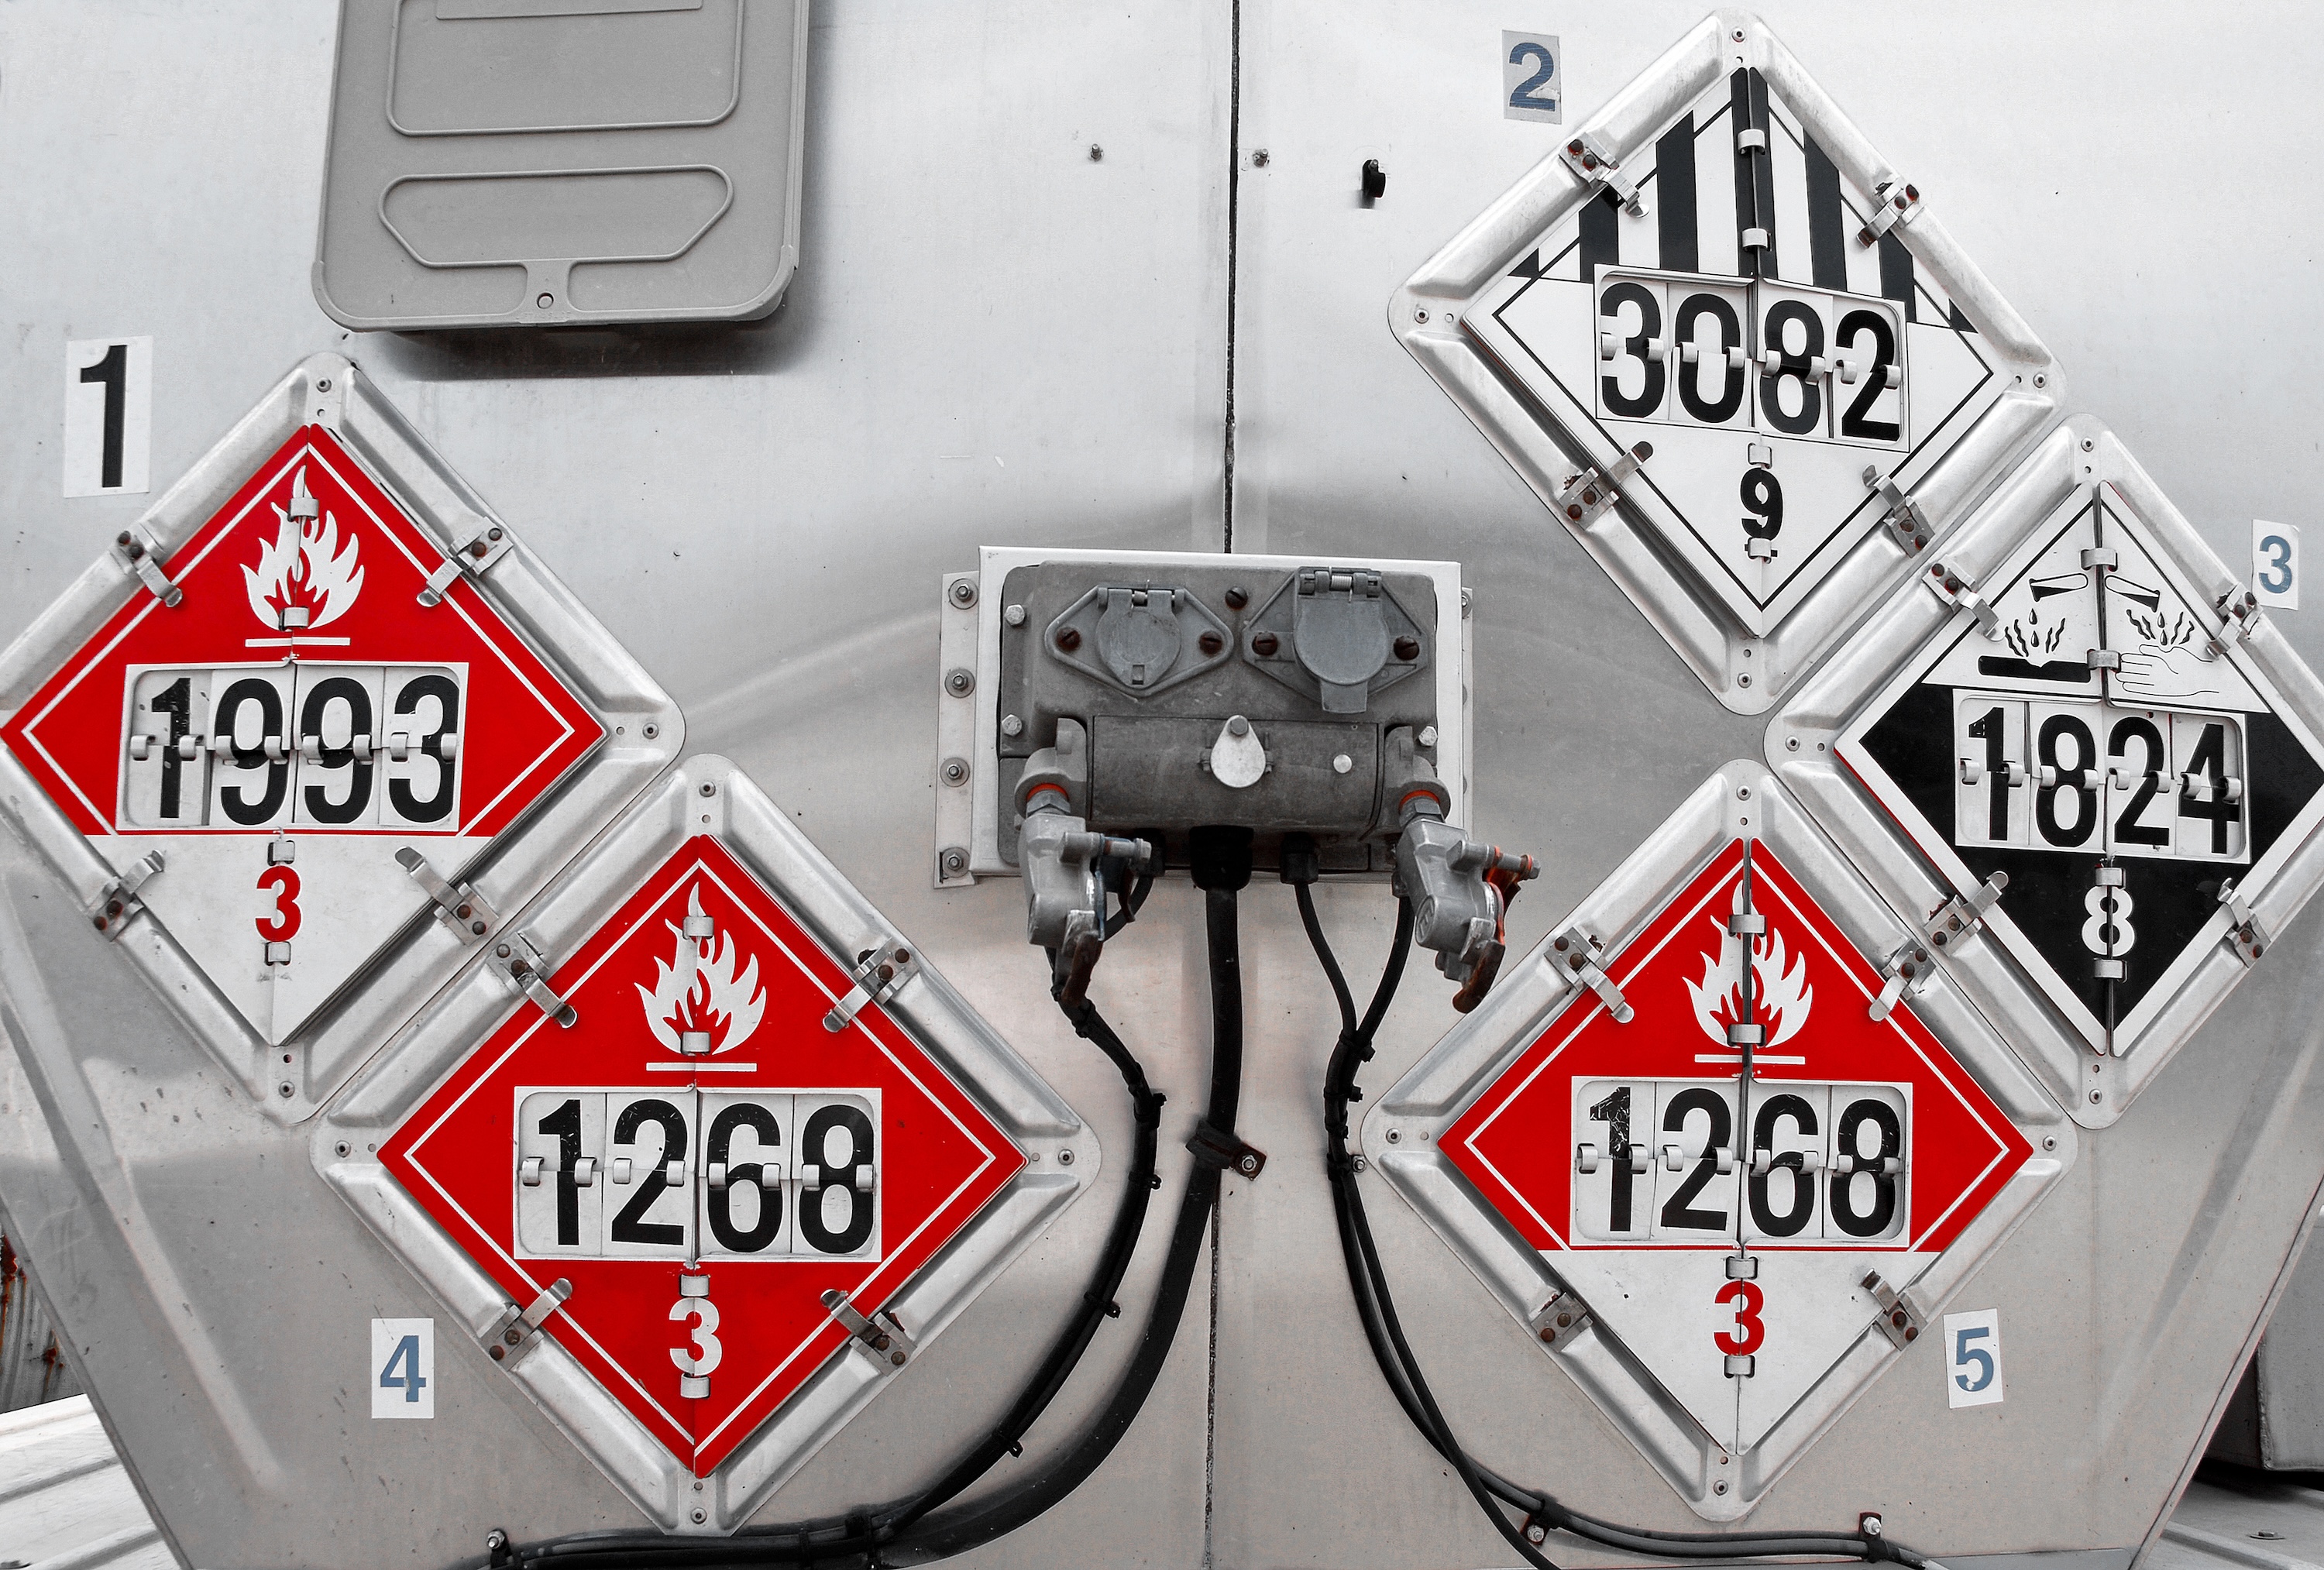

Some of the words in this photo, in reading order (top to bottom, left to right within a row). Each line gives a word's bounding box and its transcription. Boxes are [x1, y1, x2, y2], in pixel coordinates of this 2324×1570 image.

[1508, 43, 1556, 113] 2
[1600, 281, 1900, 442] 3082
[79, 345, 128, 489] 1
[1739, 467, 1783, 542] 9
[2258, 534, 2291, 594] 3
[151, 675, 460, 826] 1993
[1968, 706, 2240, 854] 1824
[255, 865, 302, 943] 3
[2081, 885, 2136, 957] 8
[537, 1098, 875, 1253] 1268
[1589, 1086, 1900, 1238] 1268
[668, 1297, 723, 1376] 3
[1713, 1280, 1765, 1356] 3
[379, 1334, 427, 1403] 4
[1953, 1325, 1996, 1393] 5
